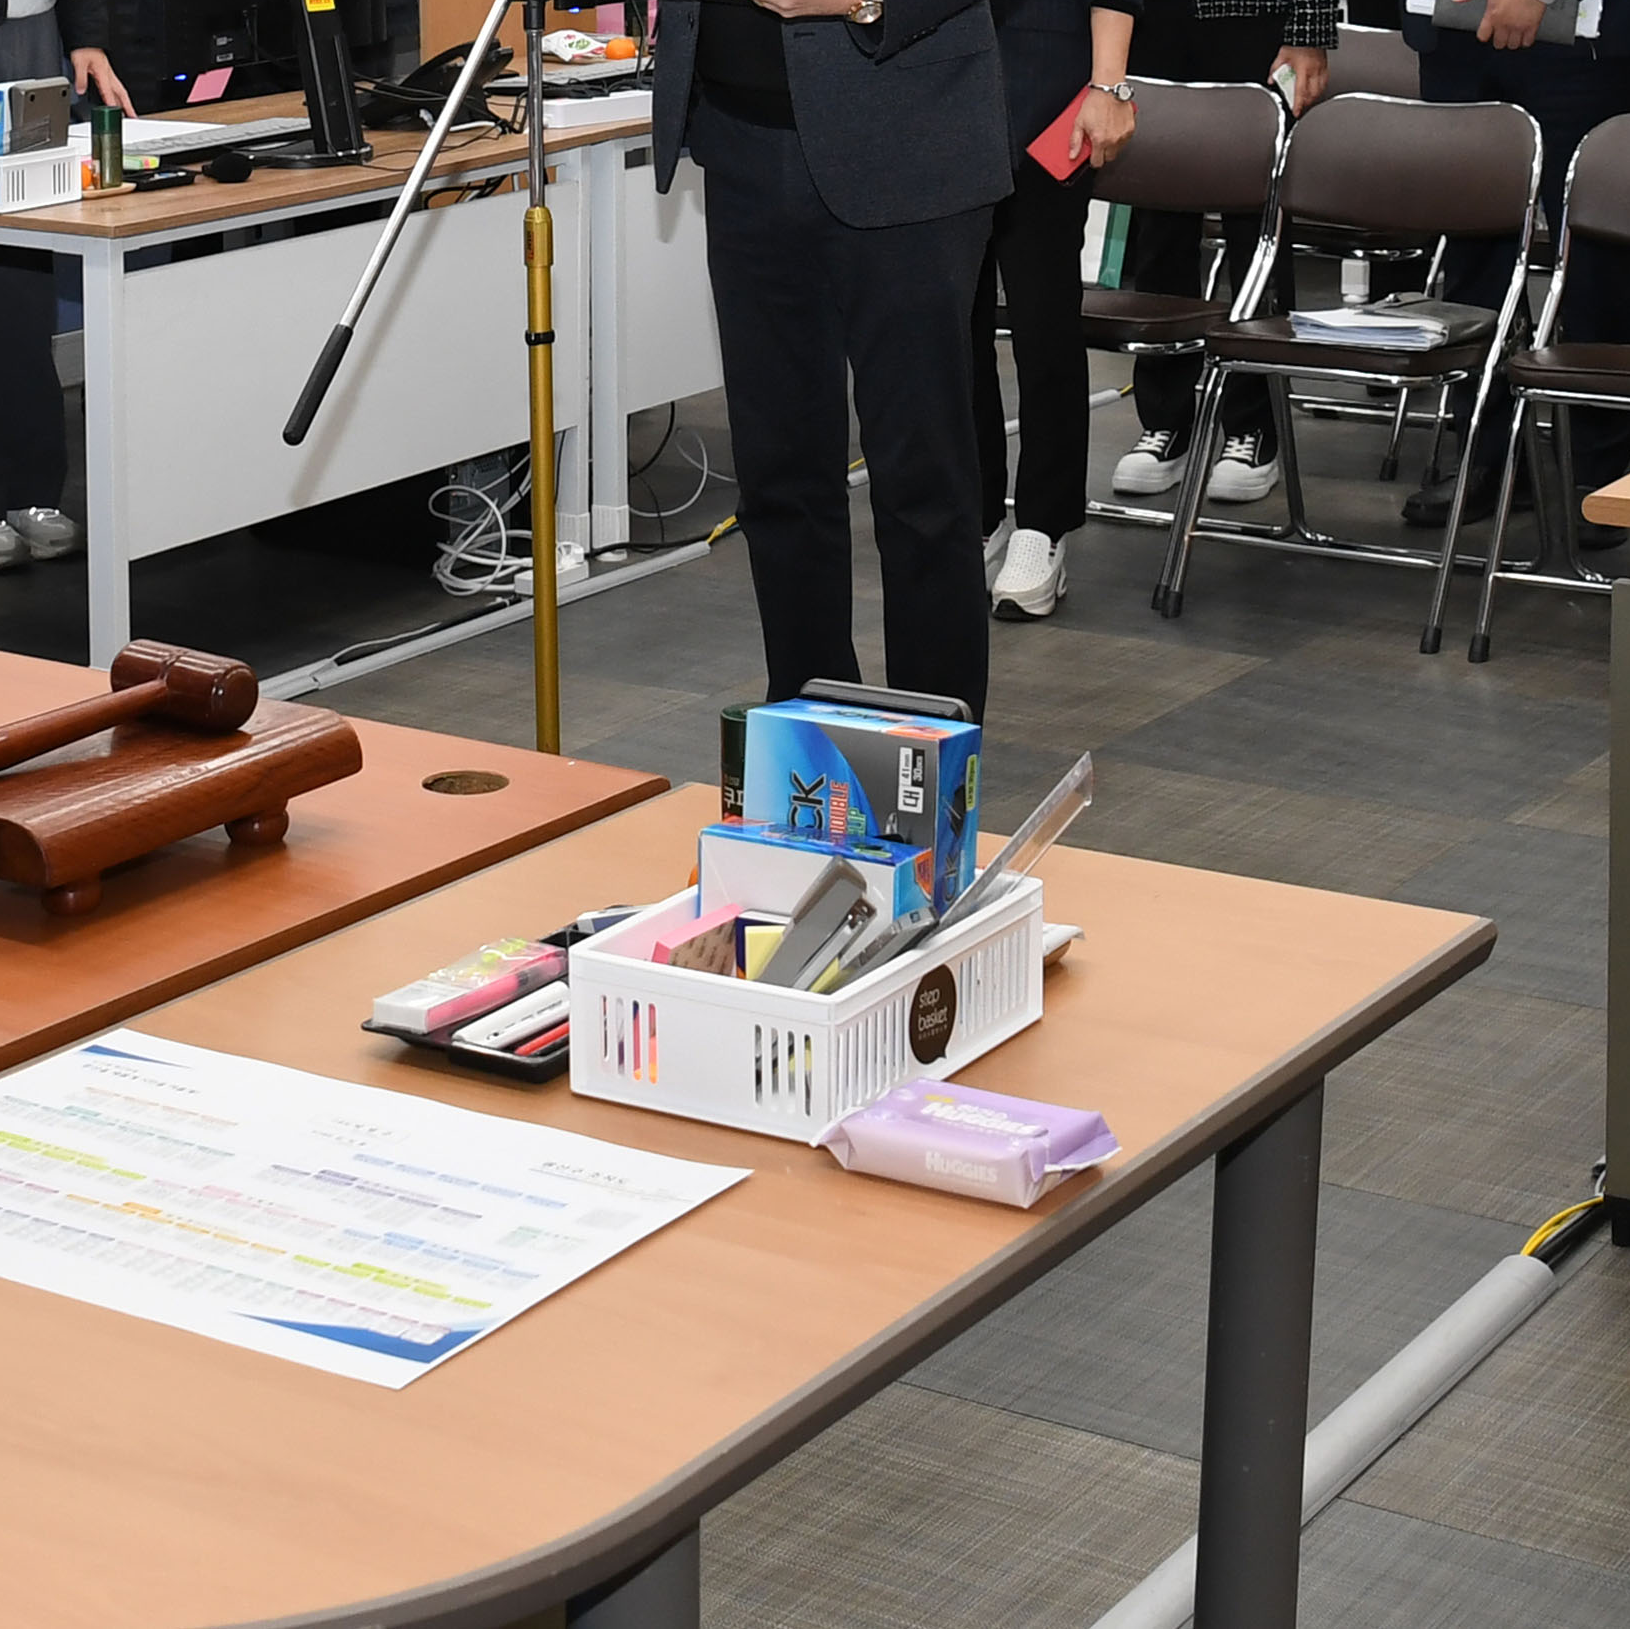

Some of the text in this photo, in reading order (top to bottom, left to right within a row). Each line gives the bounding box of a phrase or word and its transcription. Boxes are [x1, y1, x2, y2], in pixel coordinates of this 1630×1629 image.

[901, 788, 921, 809] CH
[919, 988, 940, 1009] step
[918, 1006, 948, 1032] basket
